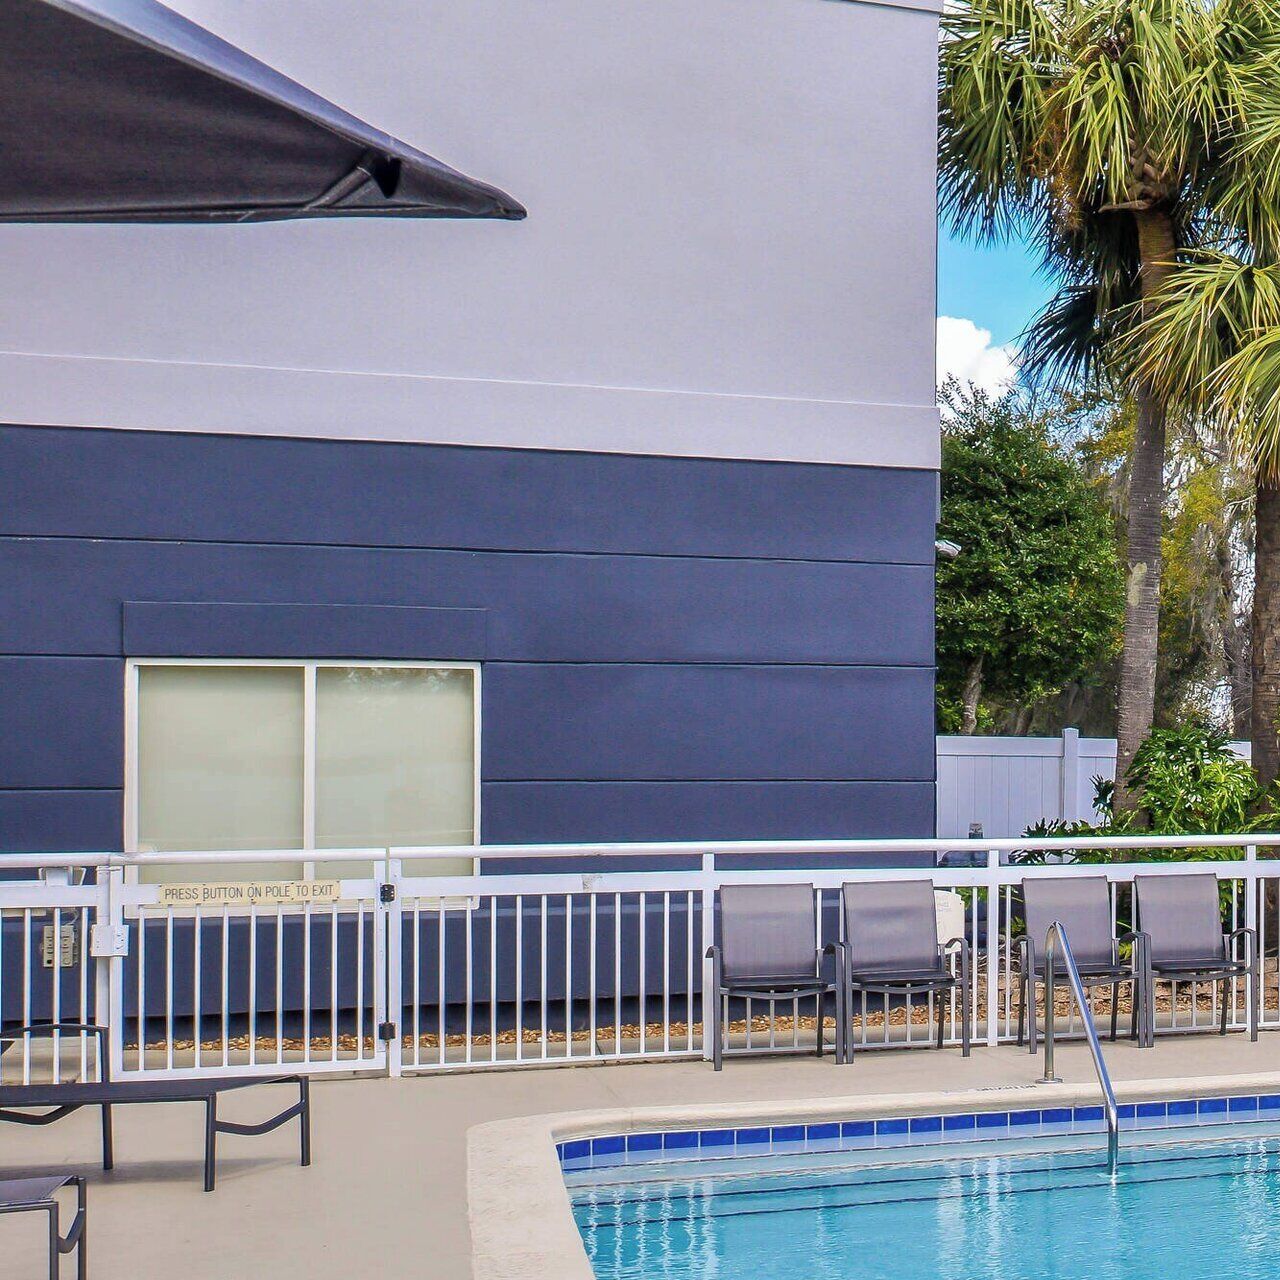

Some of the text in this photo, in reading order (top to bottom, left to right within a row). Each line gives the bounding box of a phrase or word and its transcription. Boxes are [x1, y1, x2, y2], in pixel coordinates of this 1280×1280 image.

[164, 884, 334, 900] PRESS BUTTON ON POLE TO EXIT
